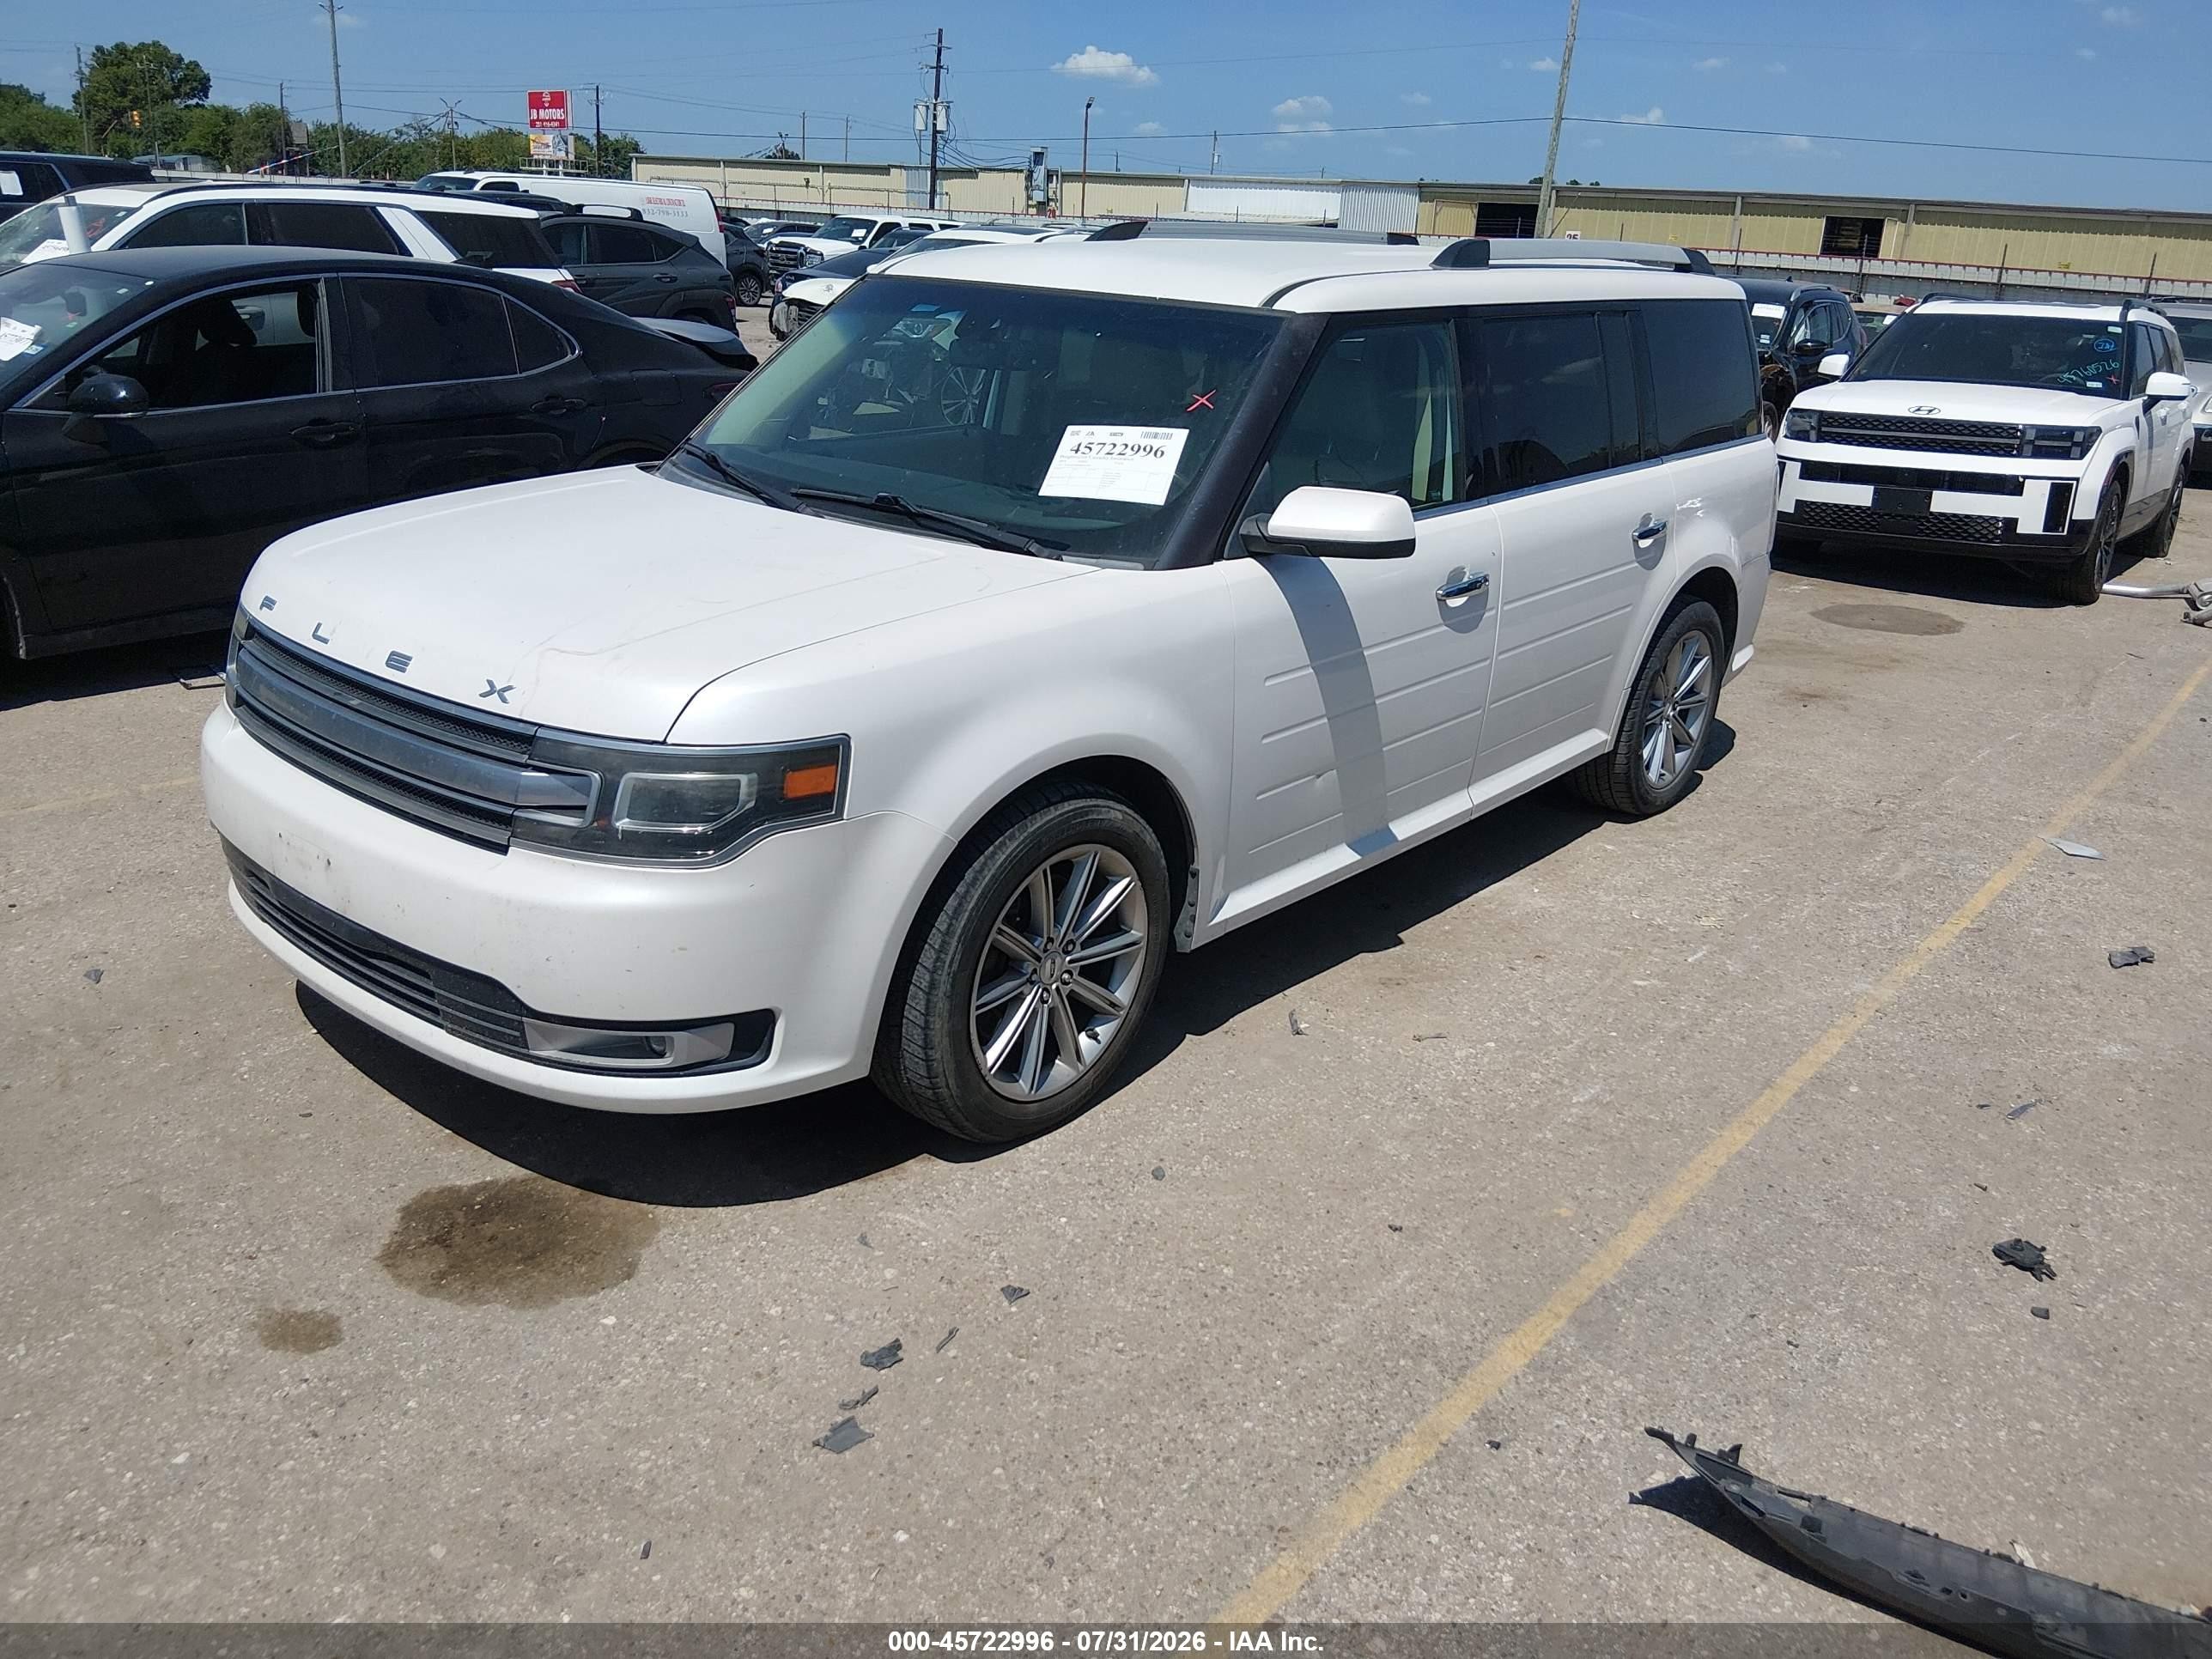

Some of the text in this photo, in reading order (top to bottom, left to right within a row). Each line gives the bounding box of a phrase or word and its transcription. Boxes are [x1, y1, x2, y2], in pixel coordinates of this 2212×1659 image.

[531, 108, 565, 119] JB MOTORS
[1070, 441, 1168, 459] 45722996
[259, 595, 516, 704] FLEX
